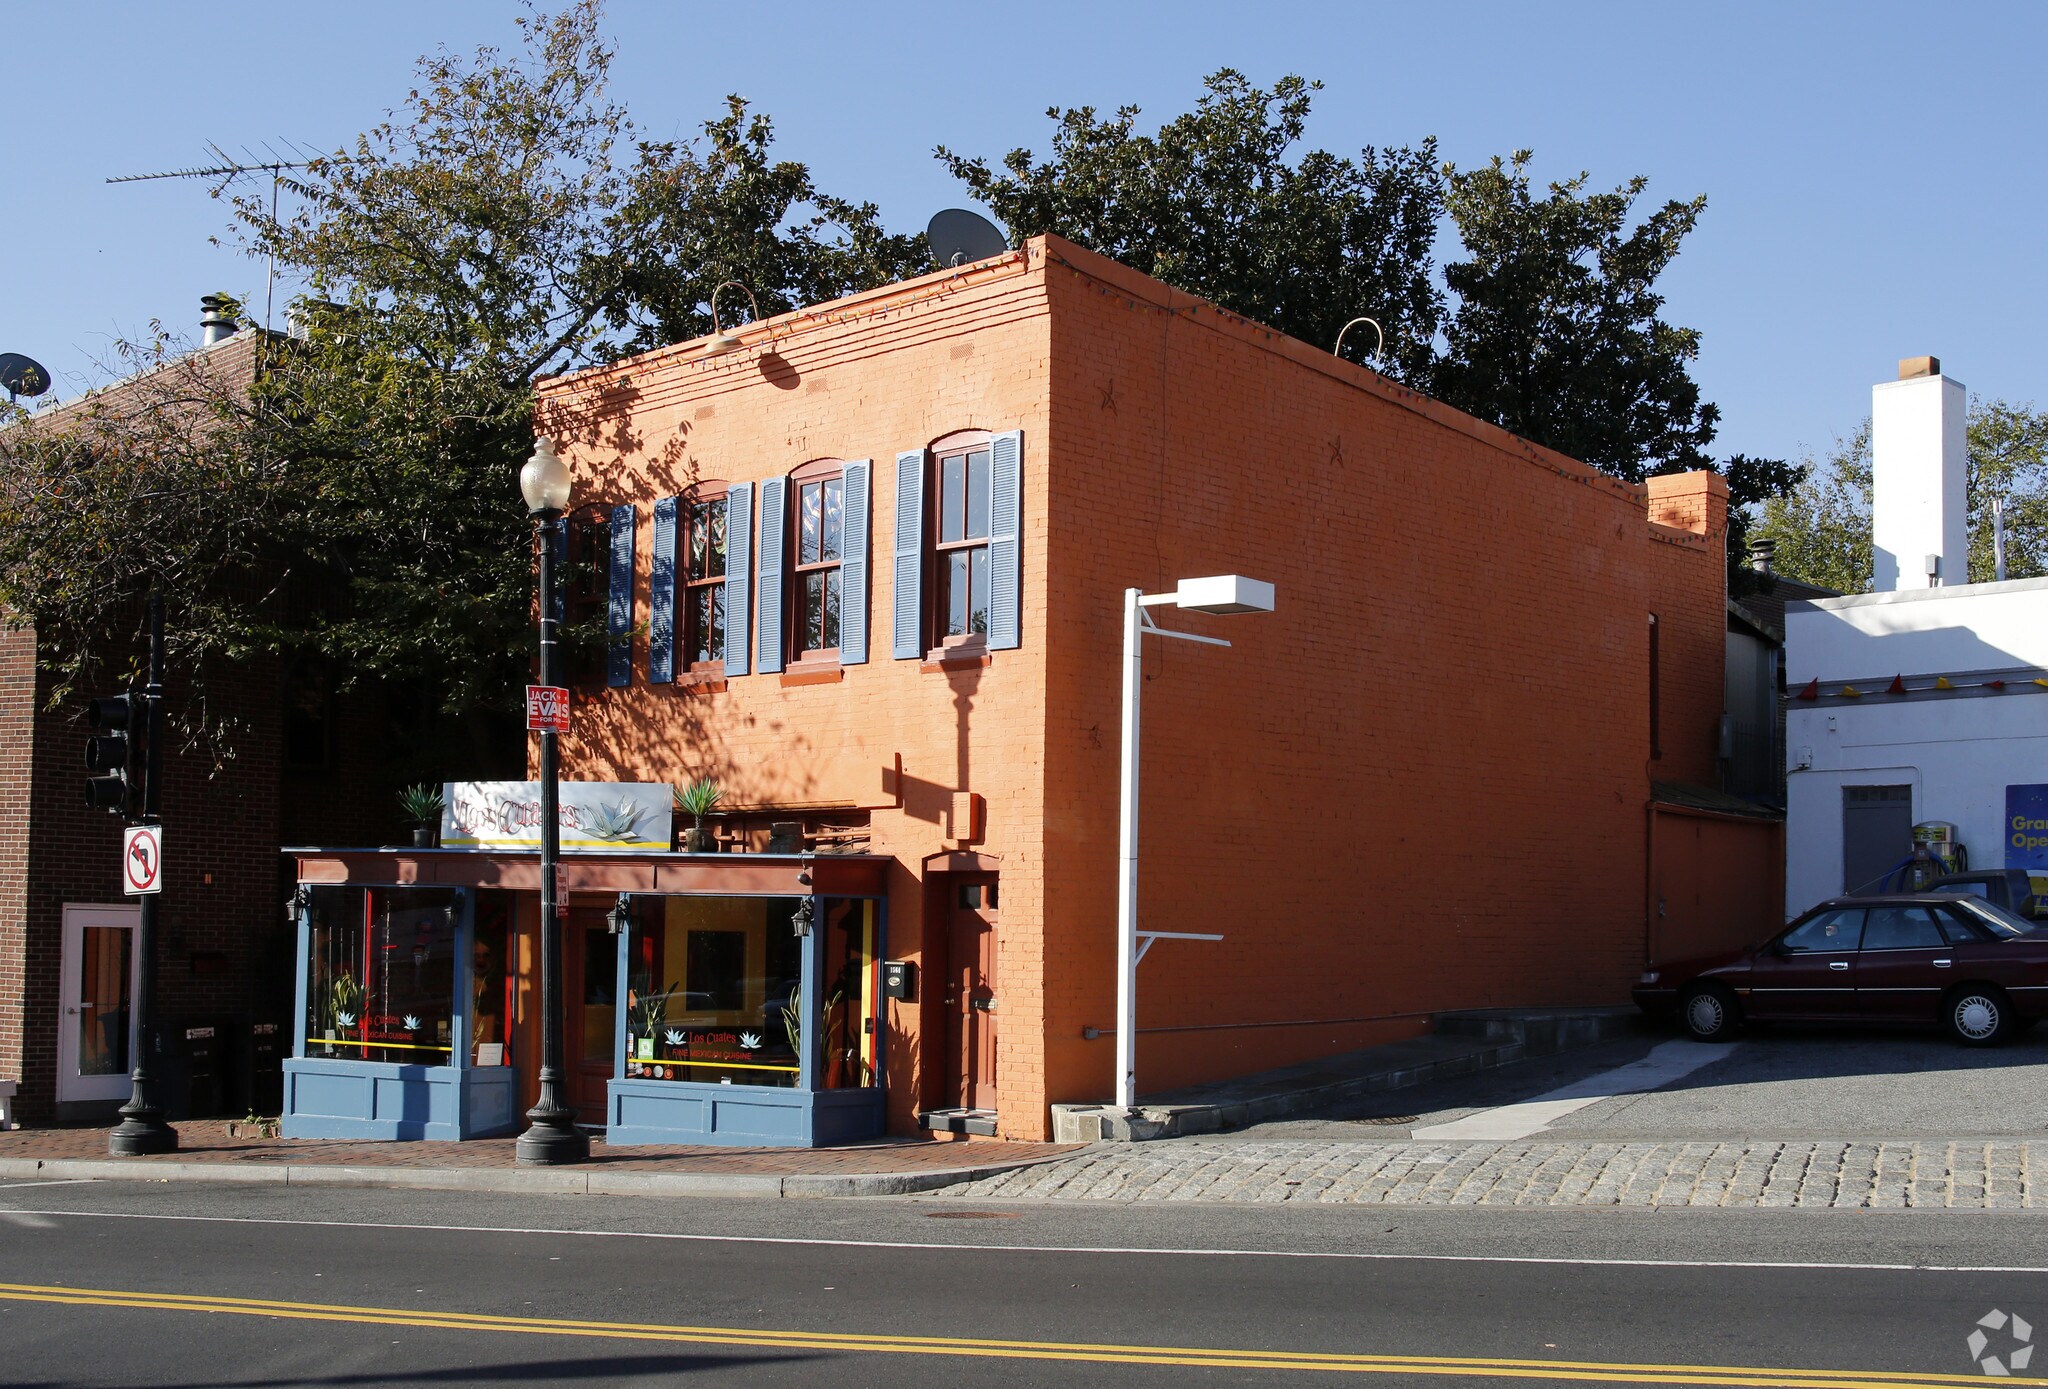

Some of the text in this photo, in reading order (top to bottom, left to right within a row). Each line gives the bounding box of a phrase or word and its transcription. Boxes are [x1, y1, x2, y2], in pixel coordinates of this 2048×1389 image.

[529, 690, 556, 702] JACK
[456, 800, 496, 834] Los
[2012, 815, 2048, 831] Gra
[689, 1031, 737, 1044] Los Cuates
[672, 1048, 753, 1061] FINE MEXICAN CUISINE
